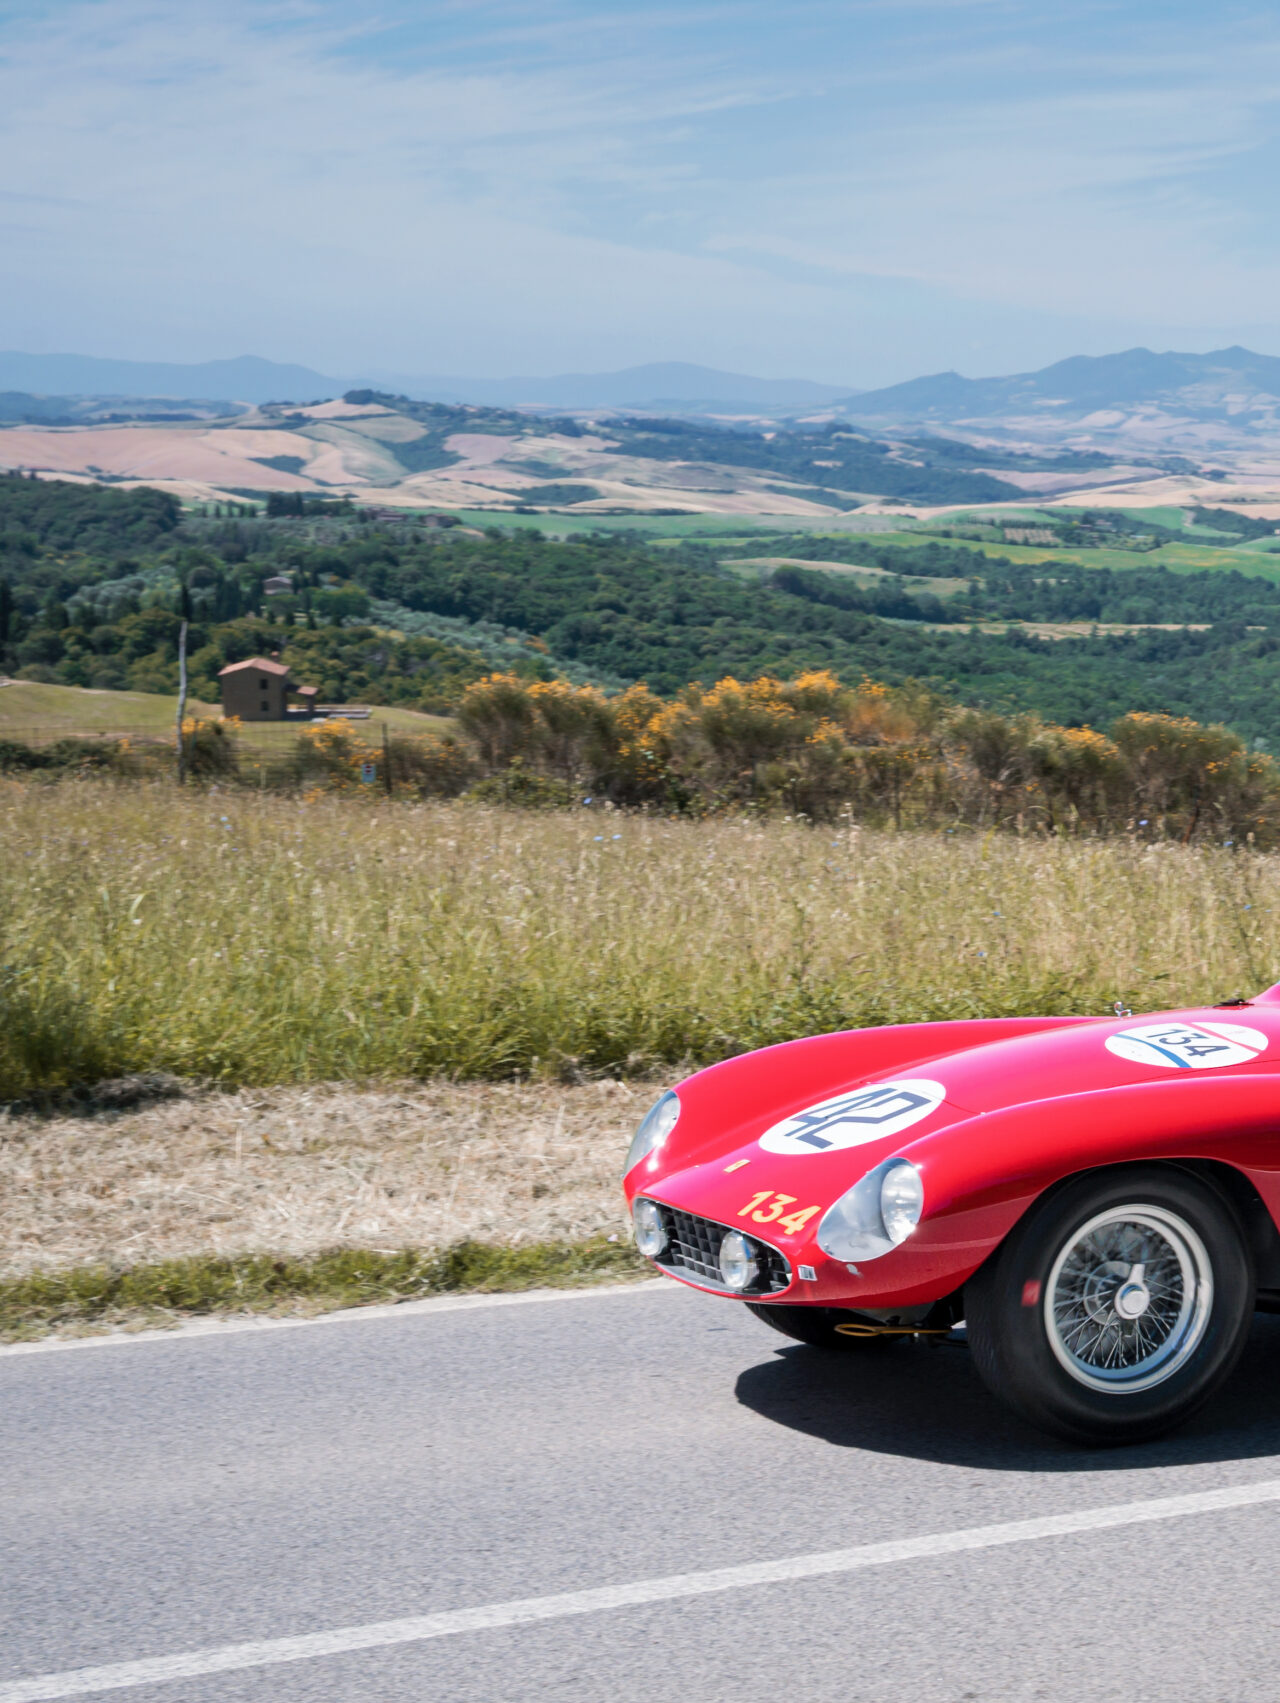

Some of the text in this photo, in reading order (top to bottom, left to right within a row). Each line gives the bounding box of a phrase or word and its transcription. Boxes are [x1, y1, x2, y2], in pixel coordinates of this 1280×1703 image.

[1146, 1029, 1231, 1057] 134
[785, 1087, 933, 1150] 42
[737, 1190, 822, 1236] 134
